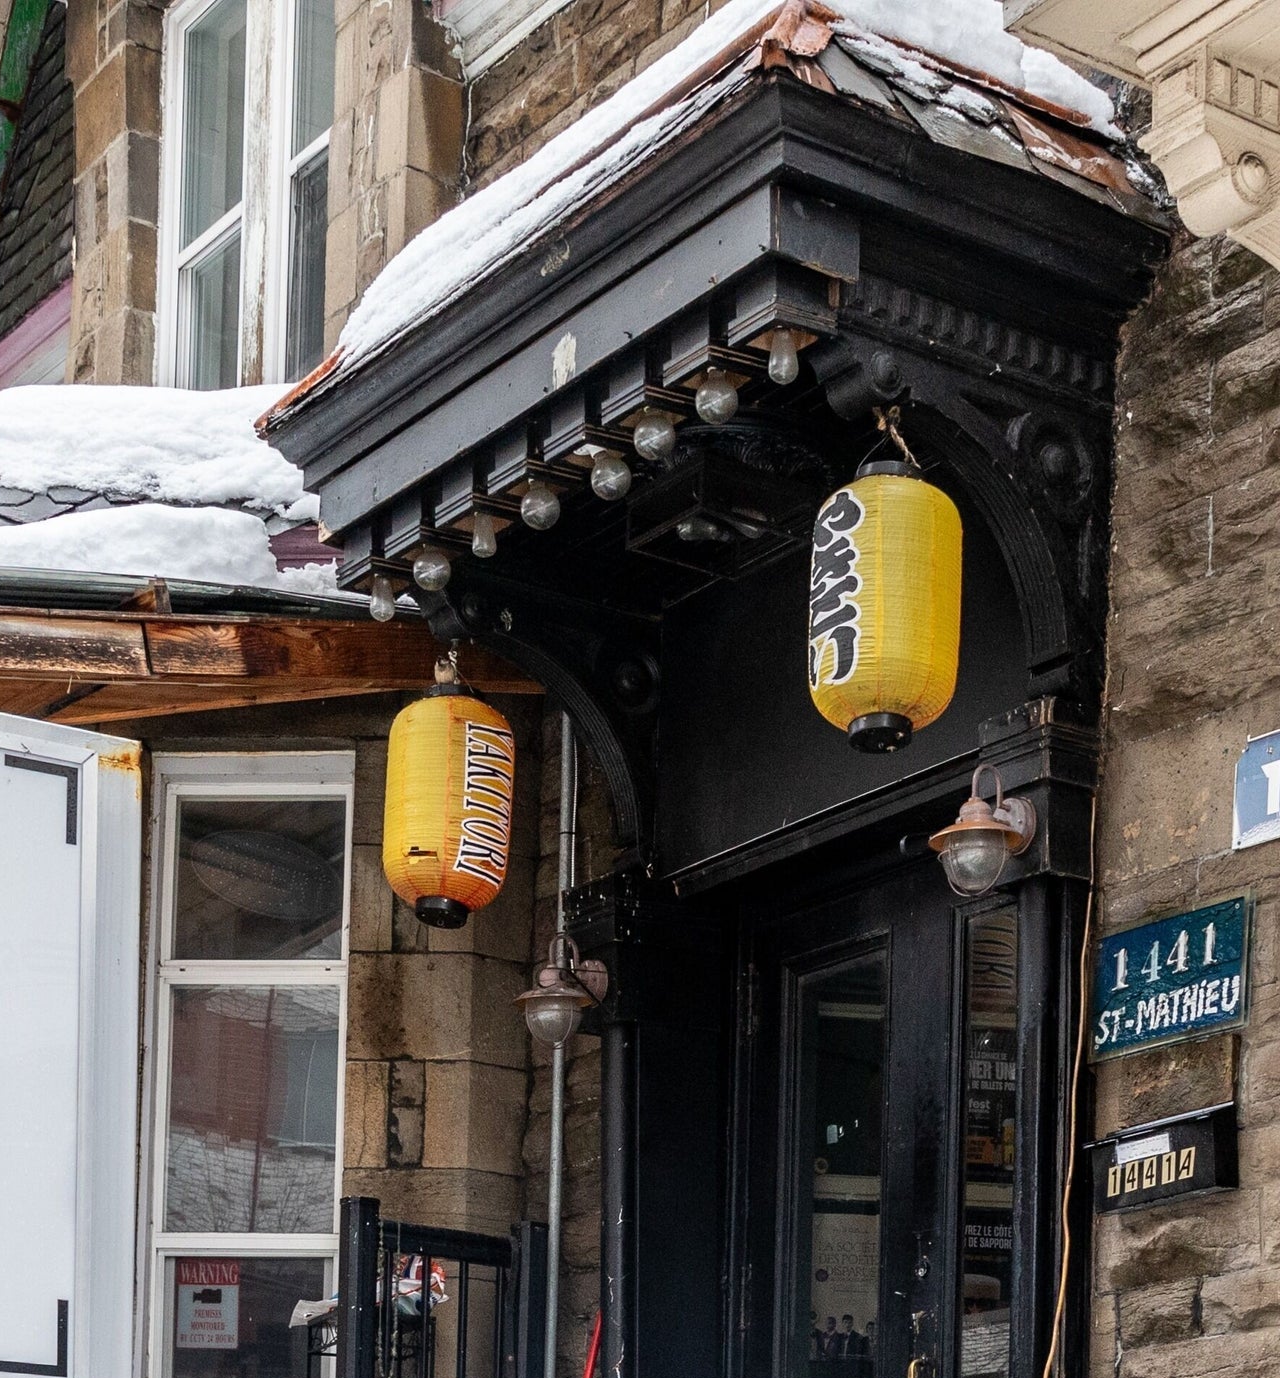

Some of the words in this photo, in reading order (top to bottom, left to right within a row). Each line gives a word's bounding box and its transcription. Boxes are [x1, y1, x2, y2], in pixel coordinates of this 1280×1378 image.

[453, 720, 513, 889] YAKITORI
[1112, 921, 1219, 991] 1441
[1110, 1149, 1193, 1195] 1441A
[180, 1263, 239, 1284] WARNING
[194, 1309, 222, 1319] PREMISES
[190, 1321, 225, 1331] MONITORED
[190, 1333, 205, 1343] CCTV
[215, 1334, 236, 1344] HOURS
